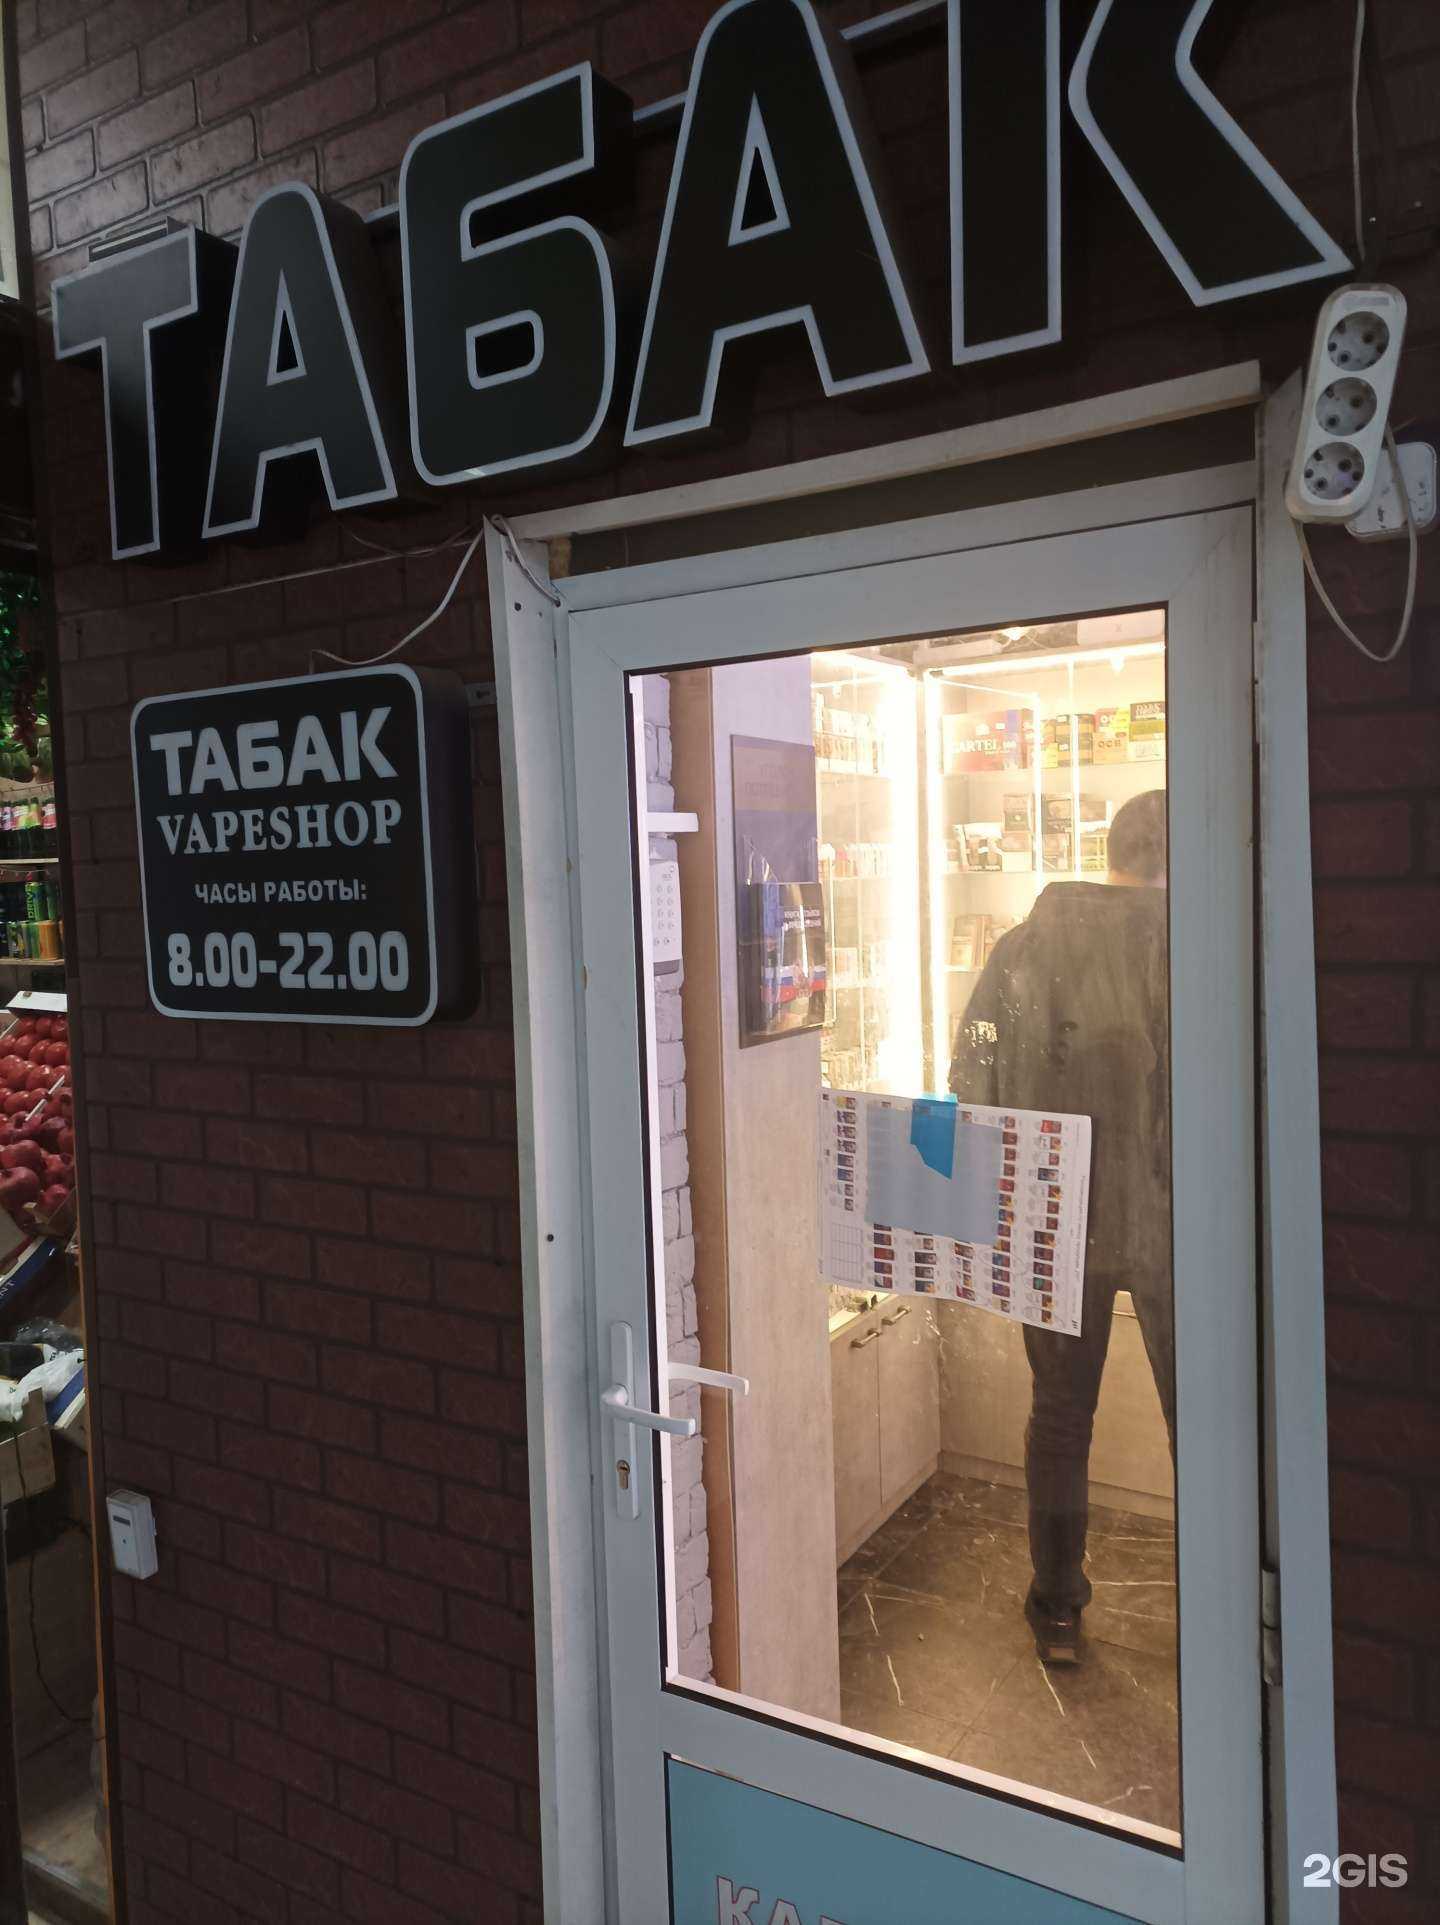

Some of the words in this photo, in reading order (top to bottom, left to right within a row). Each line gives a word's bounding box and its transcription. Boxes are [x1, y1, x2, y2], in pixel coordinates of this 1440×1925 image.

[50, 0, 1354, 561] ТАБАК
[150, 706, 399, 796] ТАБАК
[156, 799, 402, 856] VAPESHOP
[194, 882, 257, 904] ЧАСЫ
[263, 878, 367, 902] РАБОТЫ:
[167, 930, 409, 992] 8.00-22.00
